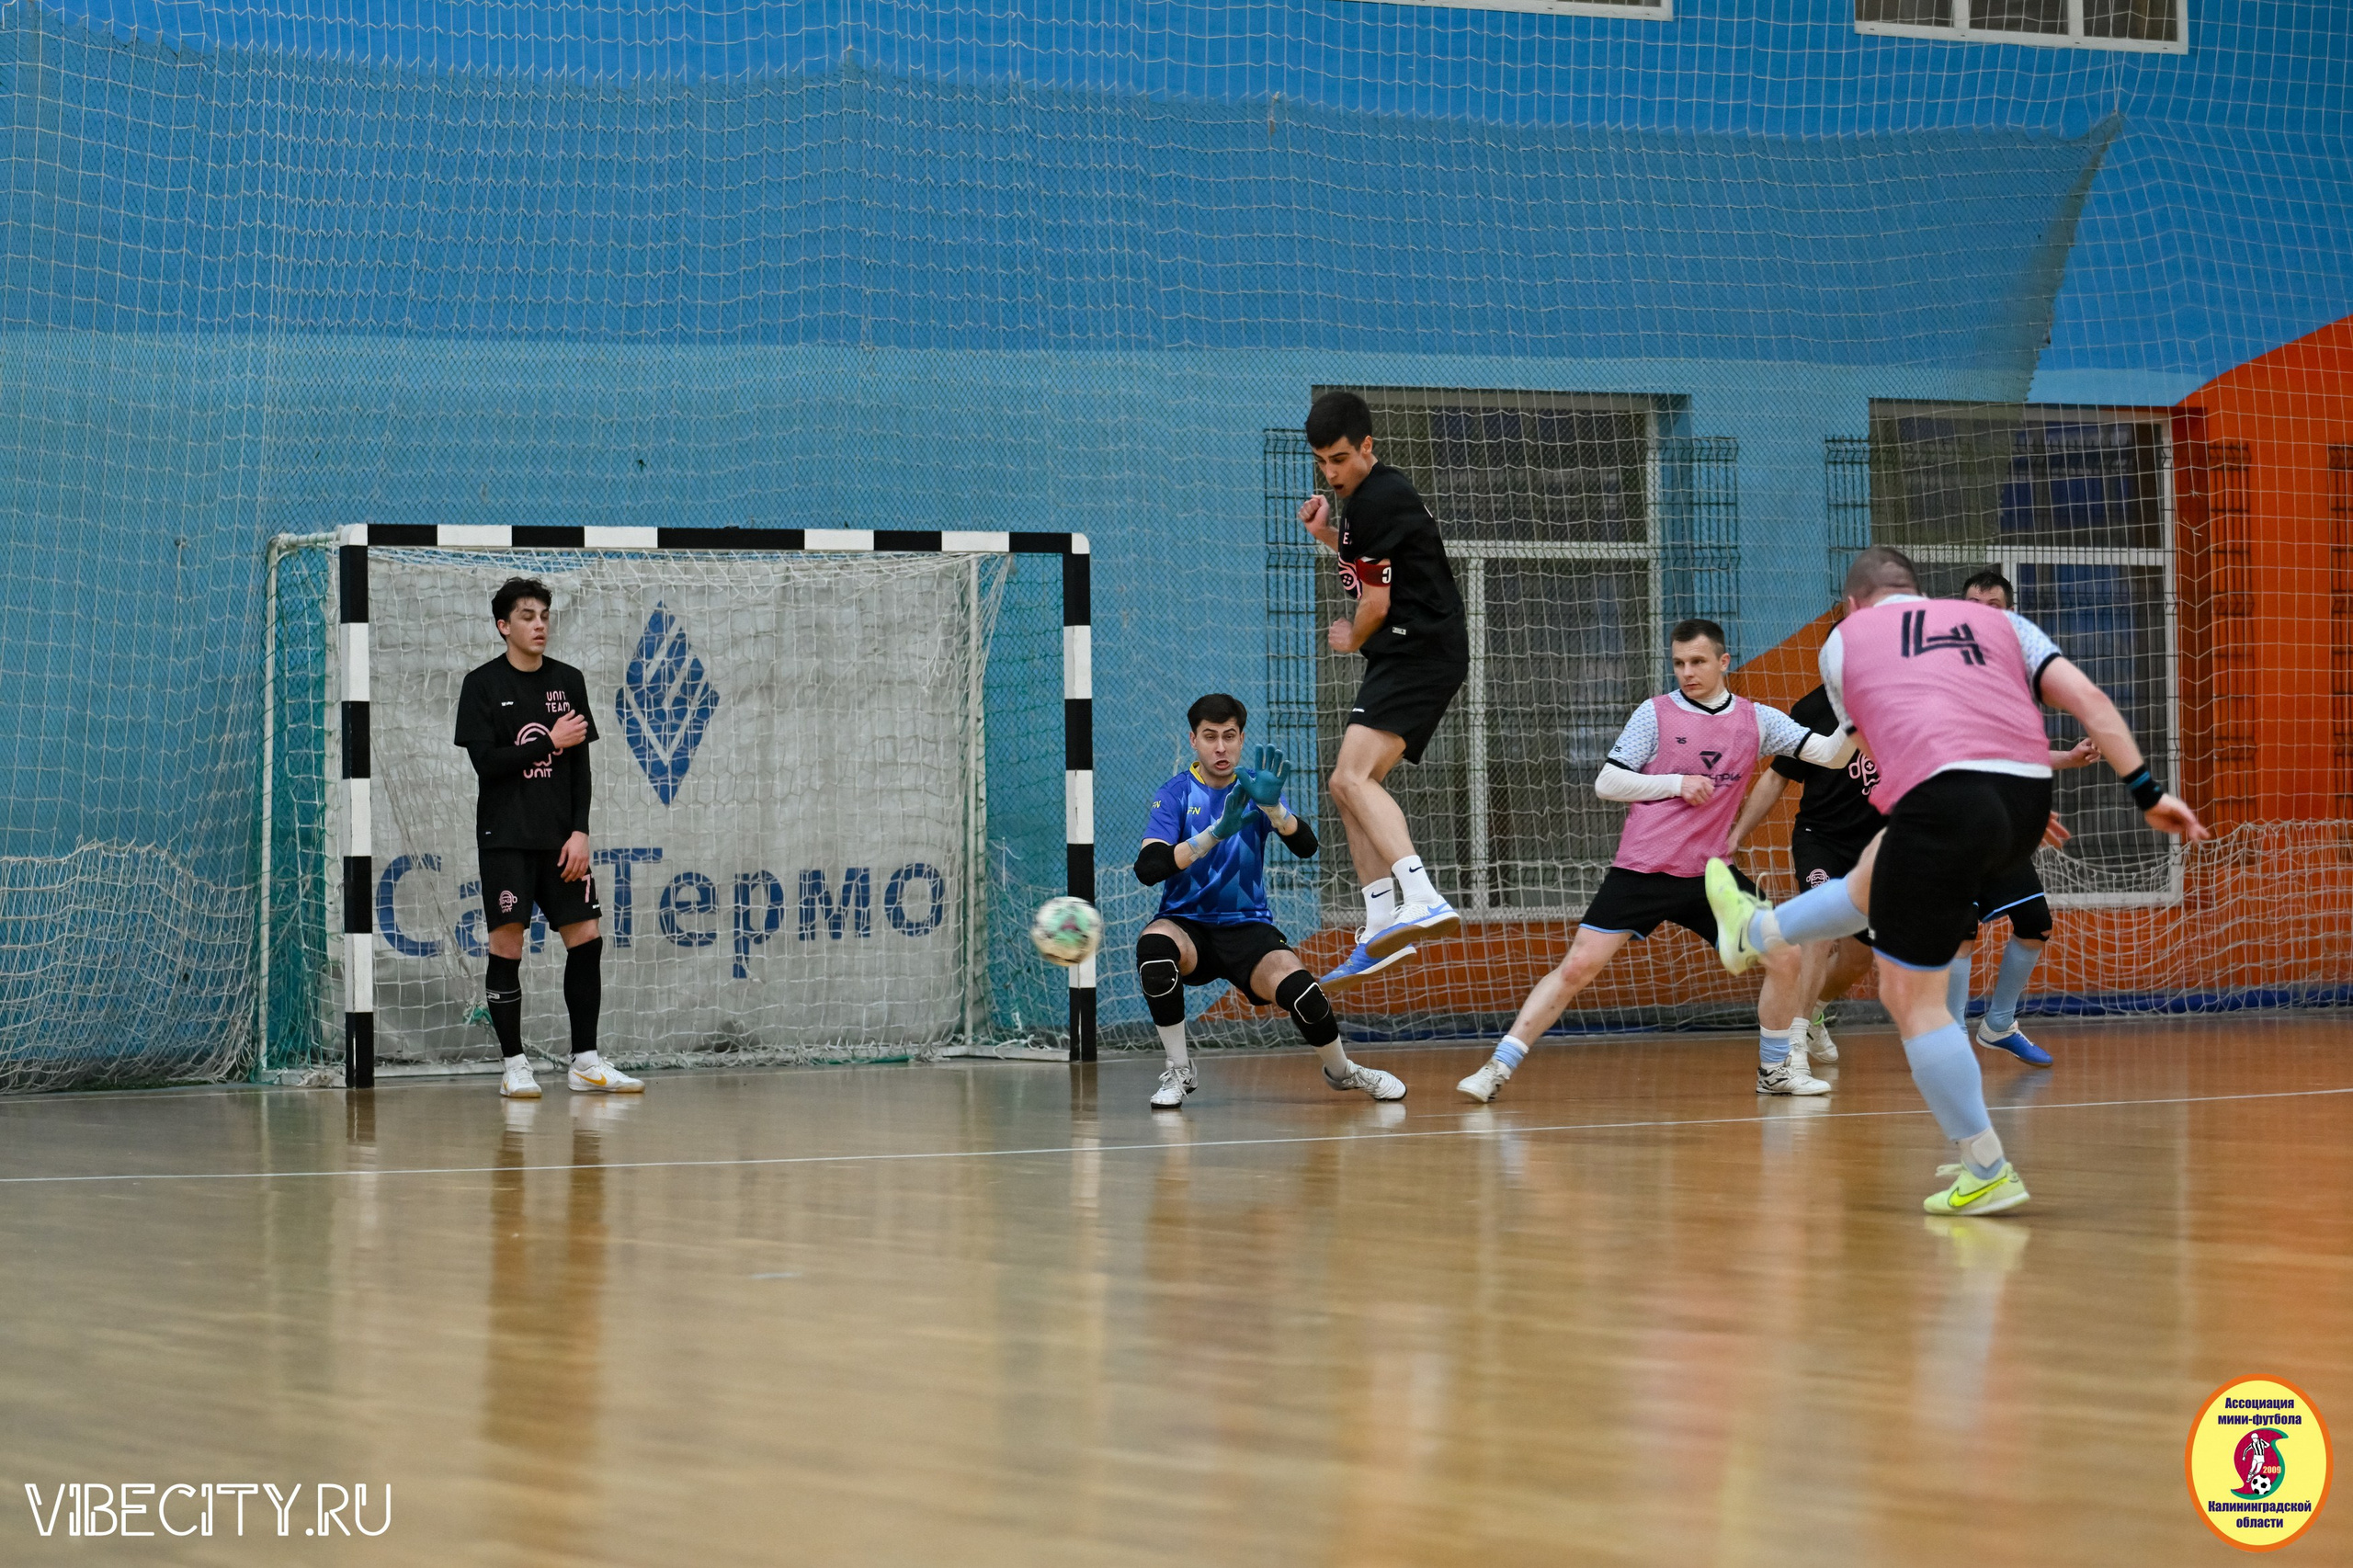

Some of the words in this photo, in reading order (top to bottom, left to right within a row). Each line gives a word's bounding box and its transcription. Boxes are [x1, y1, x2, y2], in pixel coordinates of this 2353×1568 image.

[546, 690, 566, 701] UNIT
[545, 701, 570, 713] TEAM
[523, 767, 552, 778] UNIT
